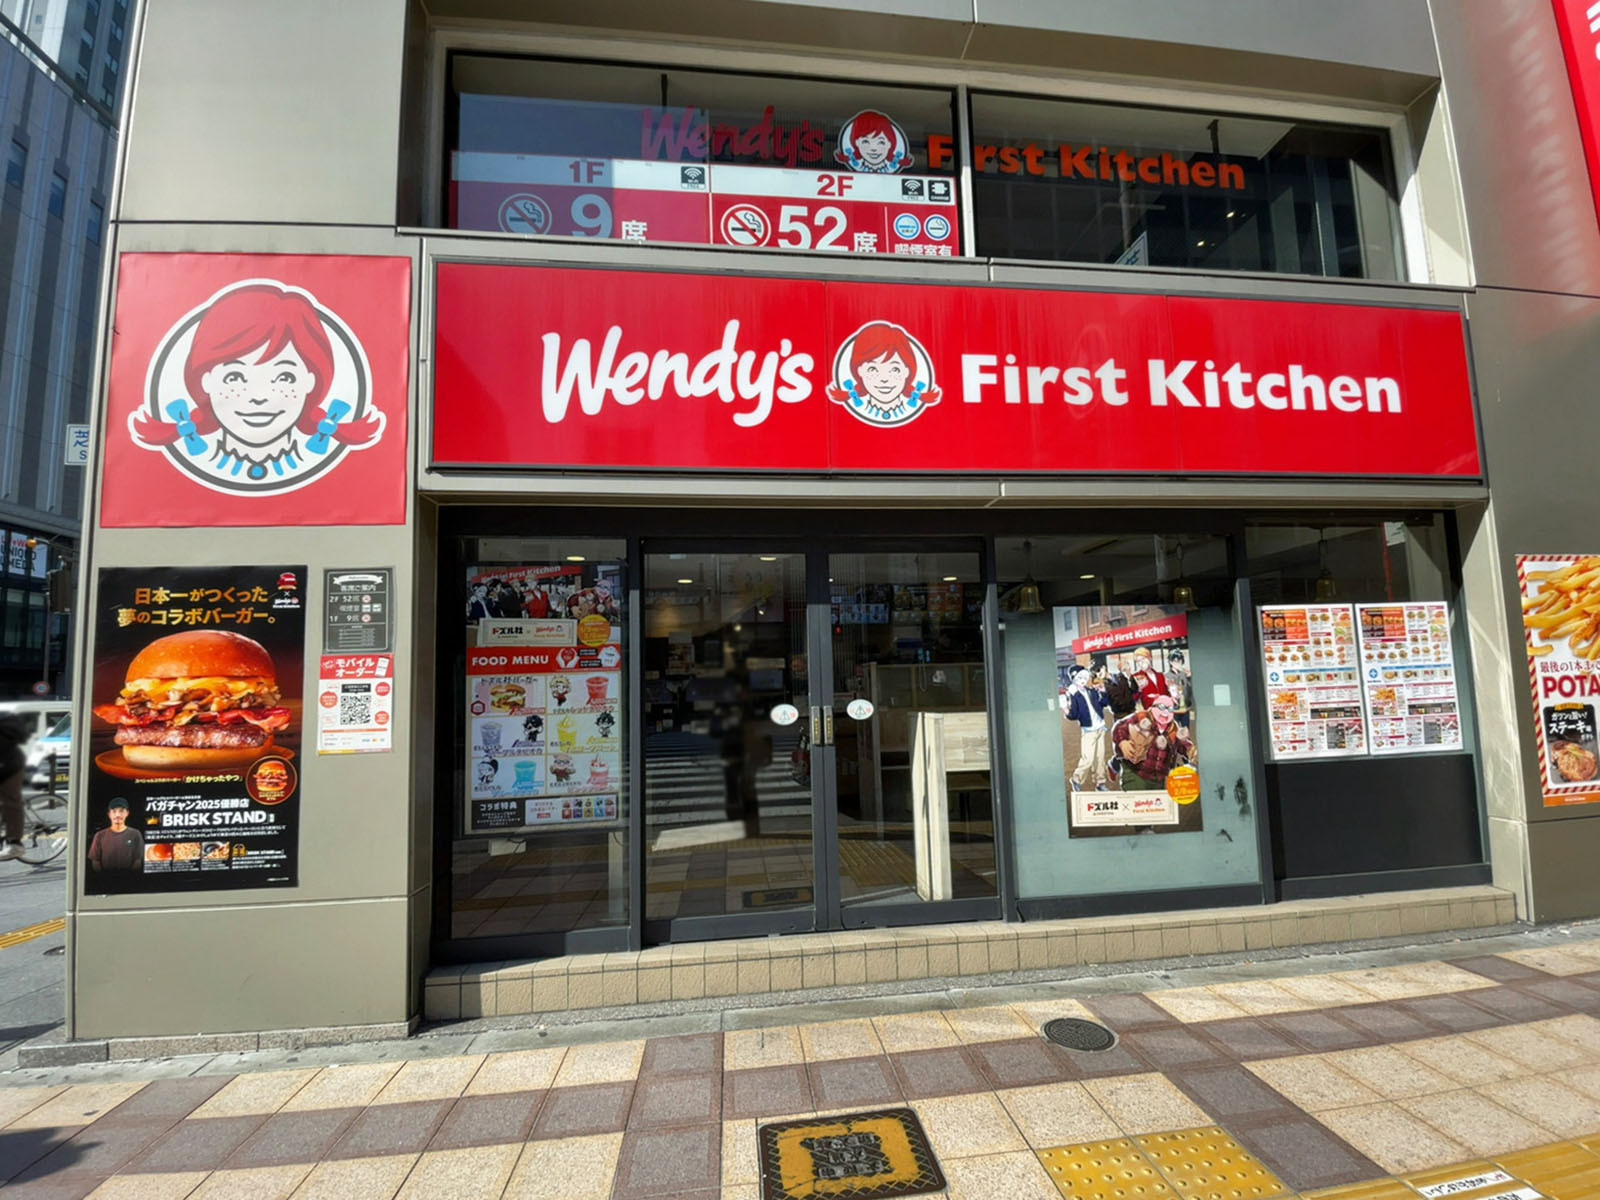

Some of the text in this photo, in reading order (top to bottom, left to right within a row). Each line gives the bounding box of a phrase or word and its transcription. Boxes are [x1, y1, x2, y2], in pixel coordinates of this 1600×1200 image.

[641, 104, 1246, 191] Wendy's Frst Kitchen
[569, 160, 605, 184] 1F
[817, 174, 854, 196] 2F
[541, 319, 1403, 428] Wendy's First Kitchen
[134, 586, 268, 605] 日本一がつくった
[117, 607, 276, 627] 夢のコラボバーガー。
[1134, 624, 1172, 638] Kitchen
[335, 657, 375, 668] モバイル
[471, 655, 549, 666] FOOD MENU
[335, 667, 374, 677] オーダー
